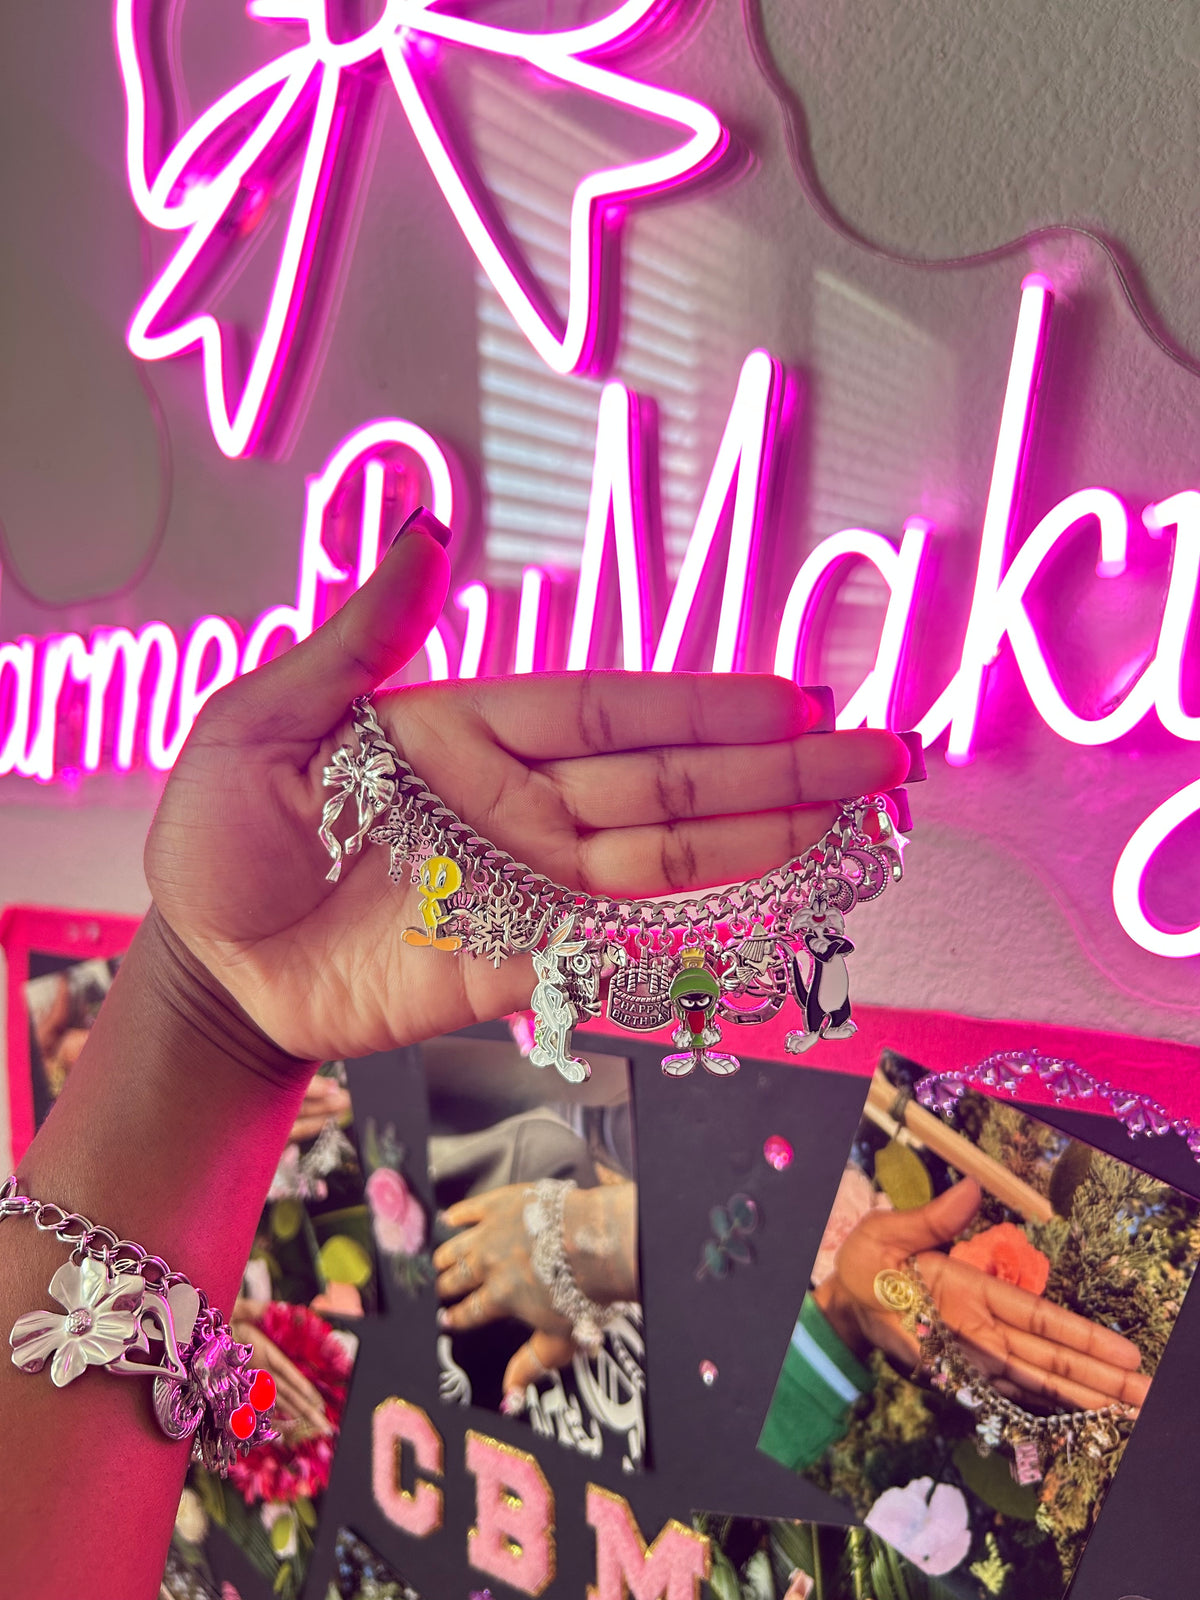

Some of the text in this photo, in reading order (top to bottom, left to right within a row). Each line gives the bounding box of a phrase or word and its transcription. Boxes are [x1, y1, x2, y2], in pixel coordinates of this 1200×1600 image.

[620, 1001, 662, 1014] HAPPY
[612, 1008, 671, 1025] BIRTHDAY
[372, 1395, 711, 1600] CBM
